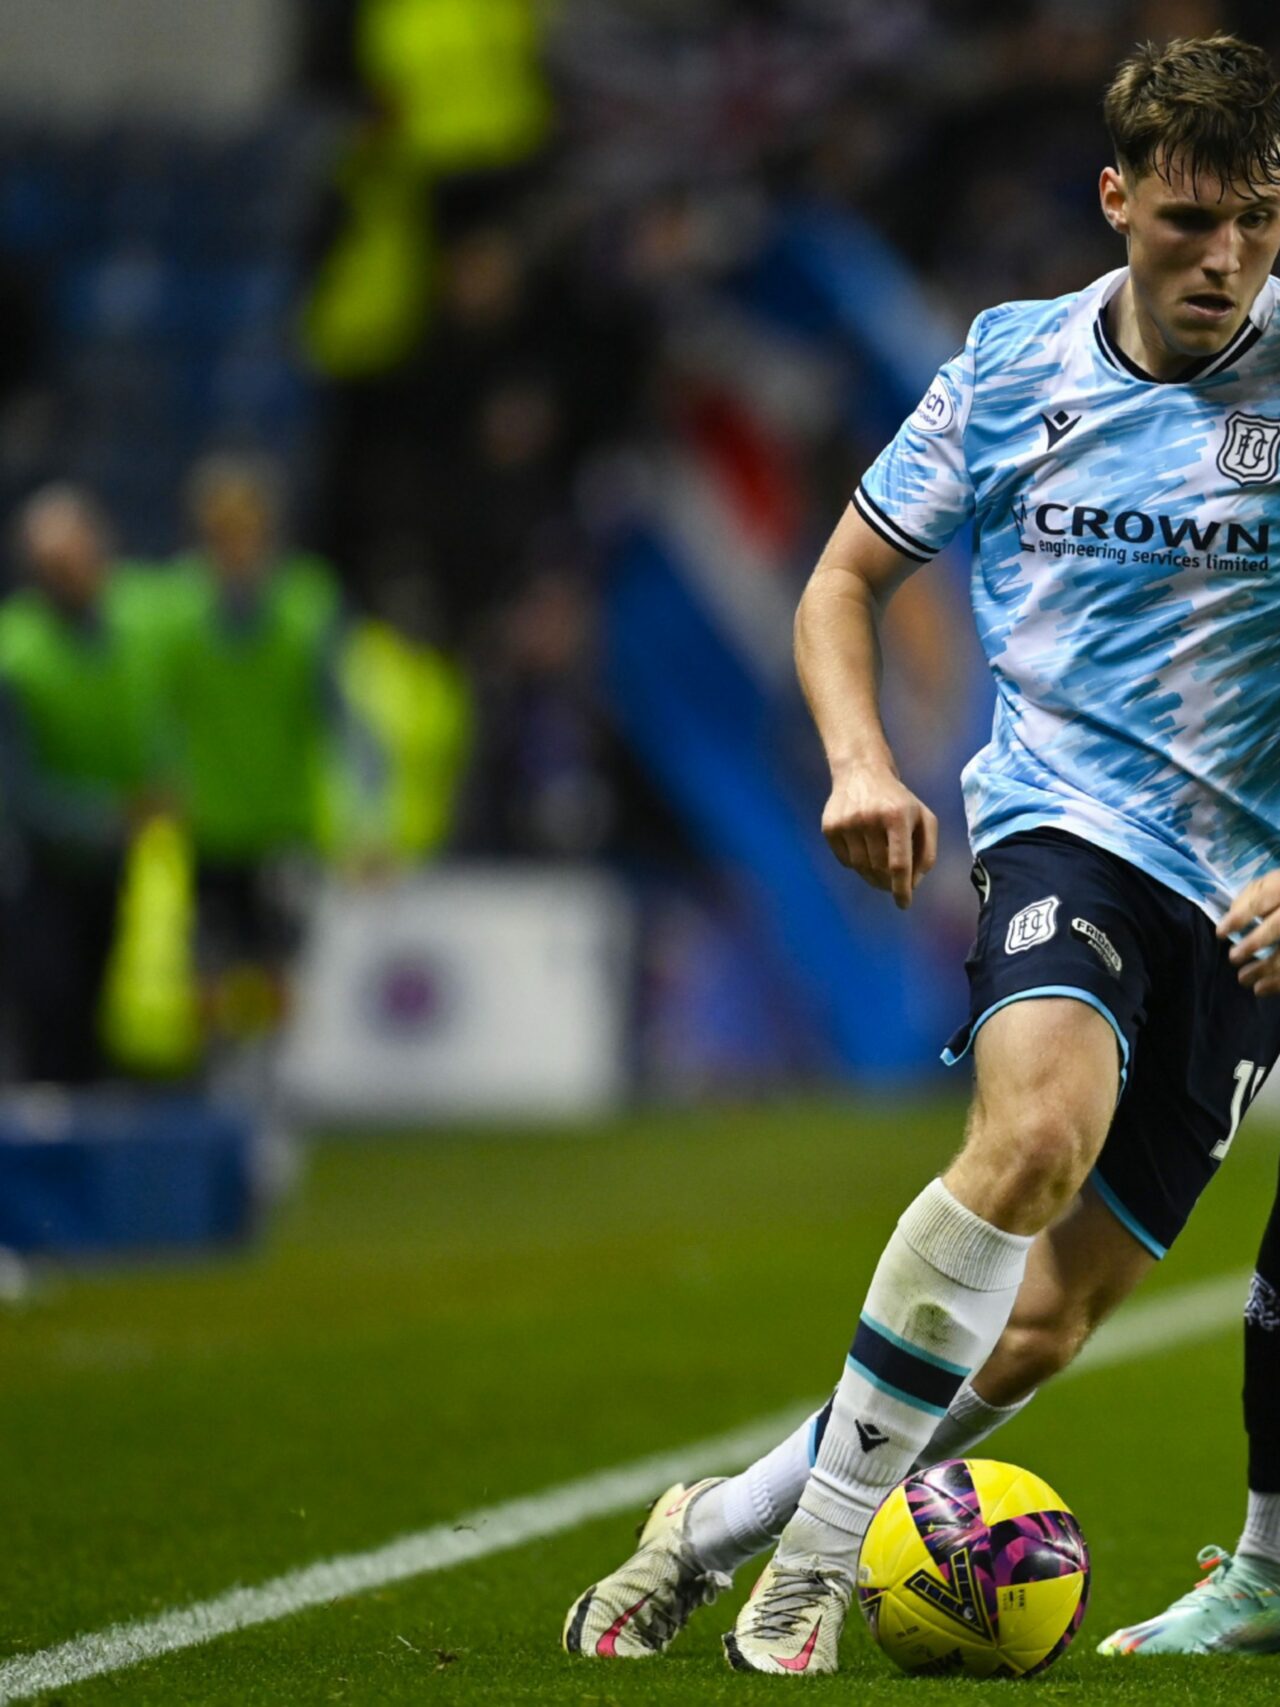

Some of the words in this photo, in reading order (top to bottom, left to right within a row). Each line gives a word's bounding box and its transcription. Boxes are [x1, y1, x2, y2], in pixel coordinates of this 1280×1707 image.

[1035, 503, 1269, 553] CROWN
[1039, 539, 1126, 565] engineering
[1132, 549, 1200, 569] services
[1206, 553, 1269, 572] limited
